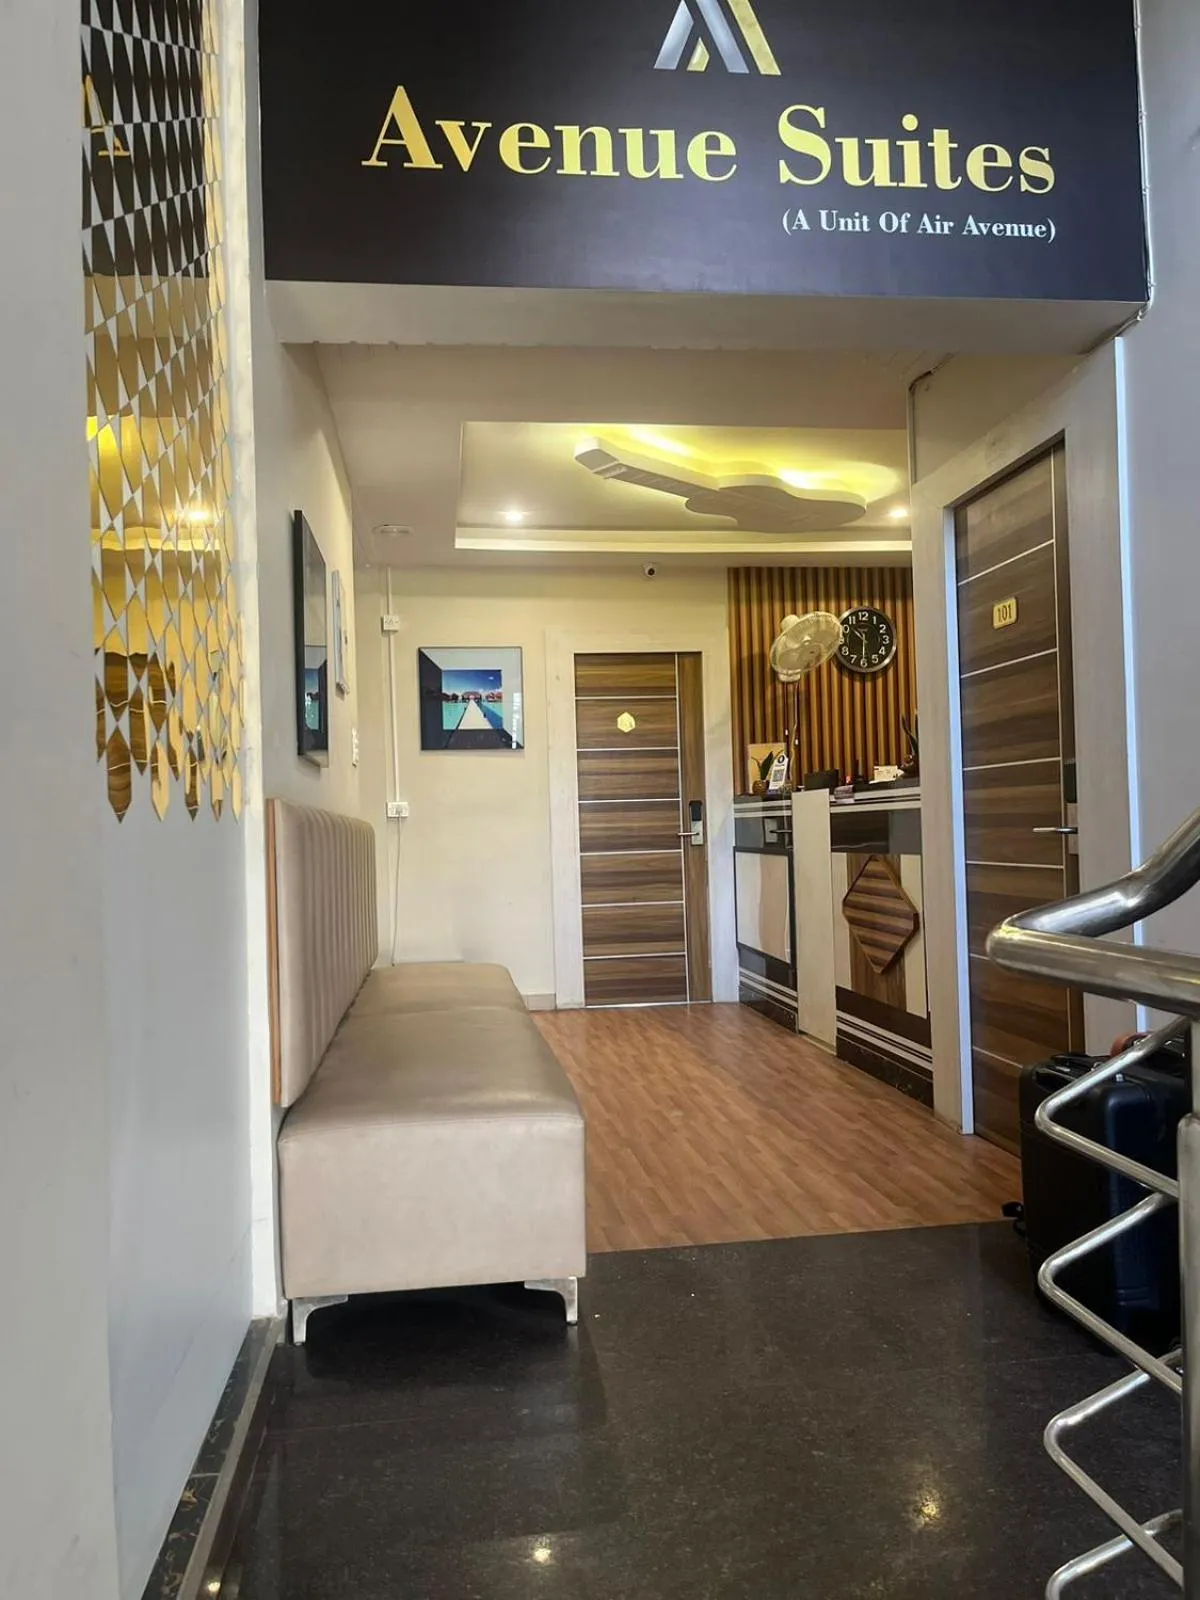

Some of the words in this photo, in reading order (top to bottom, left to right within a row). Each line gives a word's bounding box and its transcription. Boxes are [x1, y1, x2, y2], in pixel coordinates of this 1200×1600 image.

[361, 85, 737, 183] Avenue
[777, 104, 1056, 194] Suites
[782, 209, 810, 235] (A
[819, 209, 870, 234] Unit
[878, 211, 911, 235] Of
[916, 212, 954, 237] Air
[962, 213, 1056, 241] Avenue)
[858, 611, 869, 621] 12
[997, 603, 1012, 622] 101
[848, 616, 856, 625] 11
[872, 616, 877, 625] 1
[879, 624, 886, 633] 2
[883, 635, 889, 644] 3
[841, 646, 849, 655] 8
[879, 646, 886, 655] 4
[850, 654, 857, 664] 7
[860, 658, 867, 668] 6
[871, 654, 879, 664] 5
